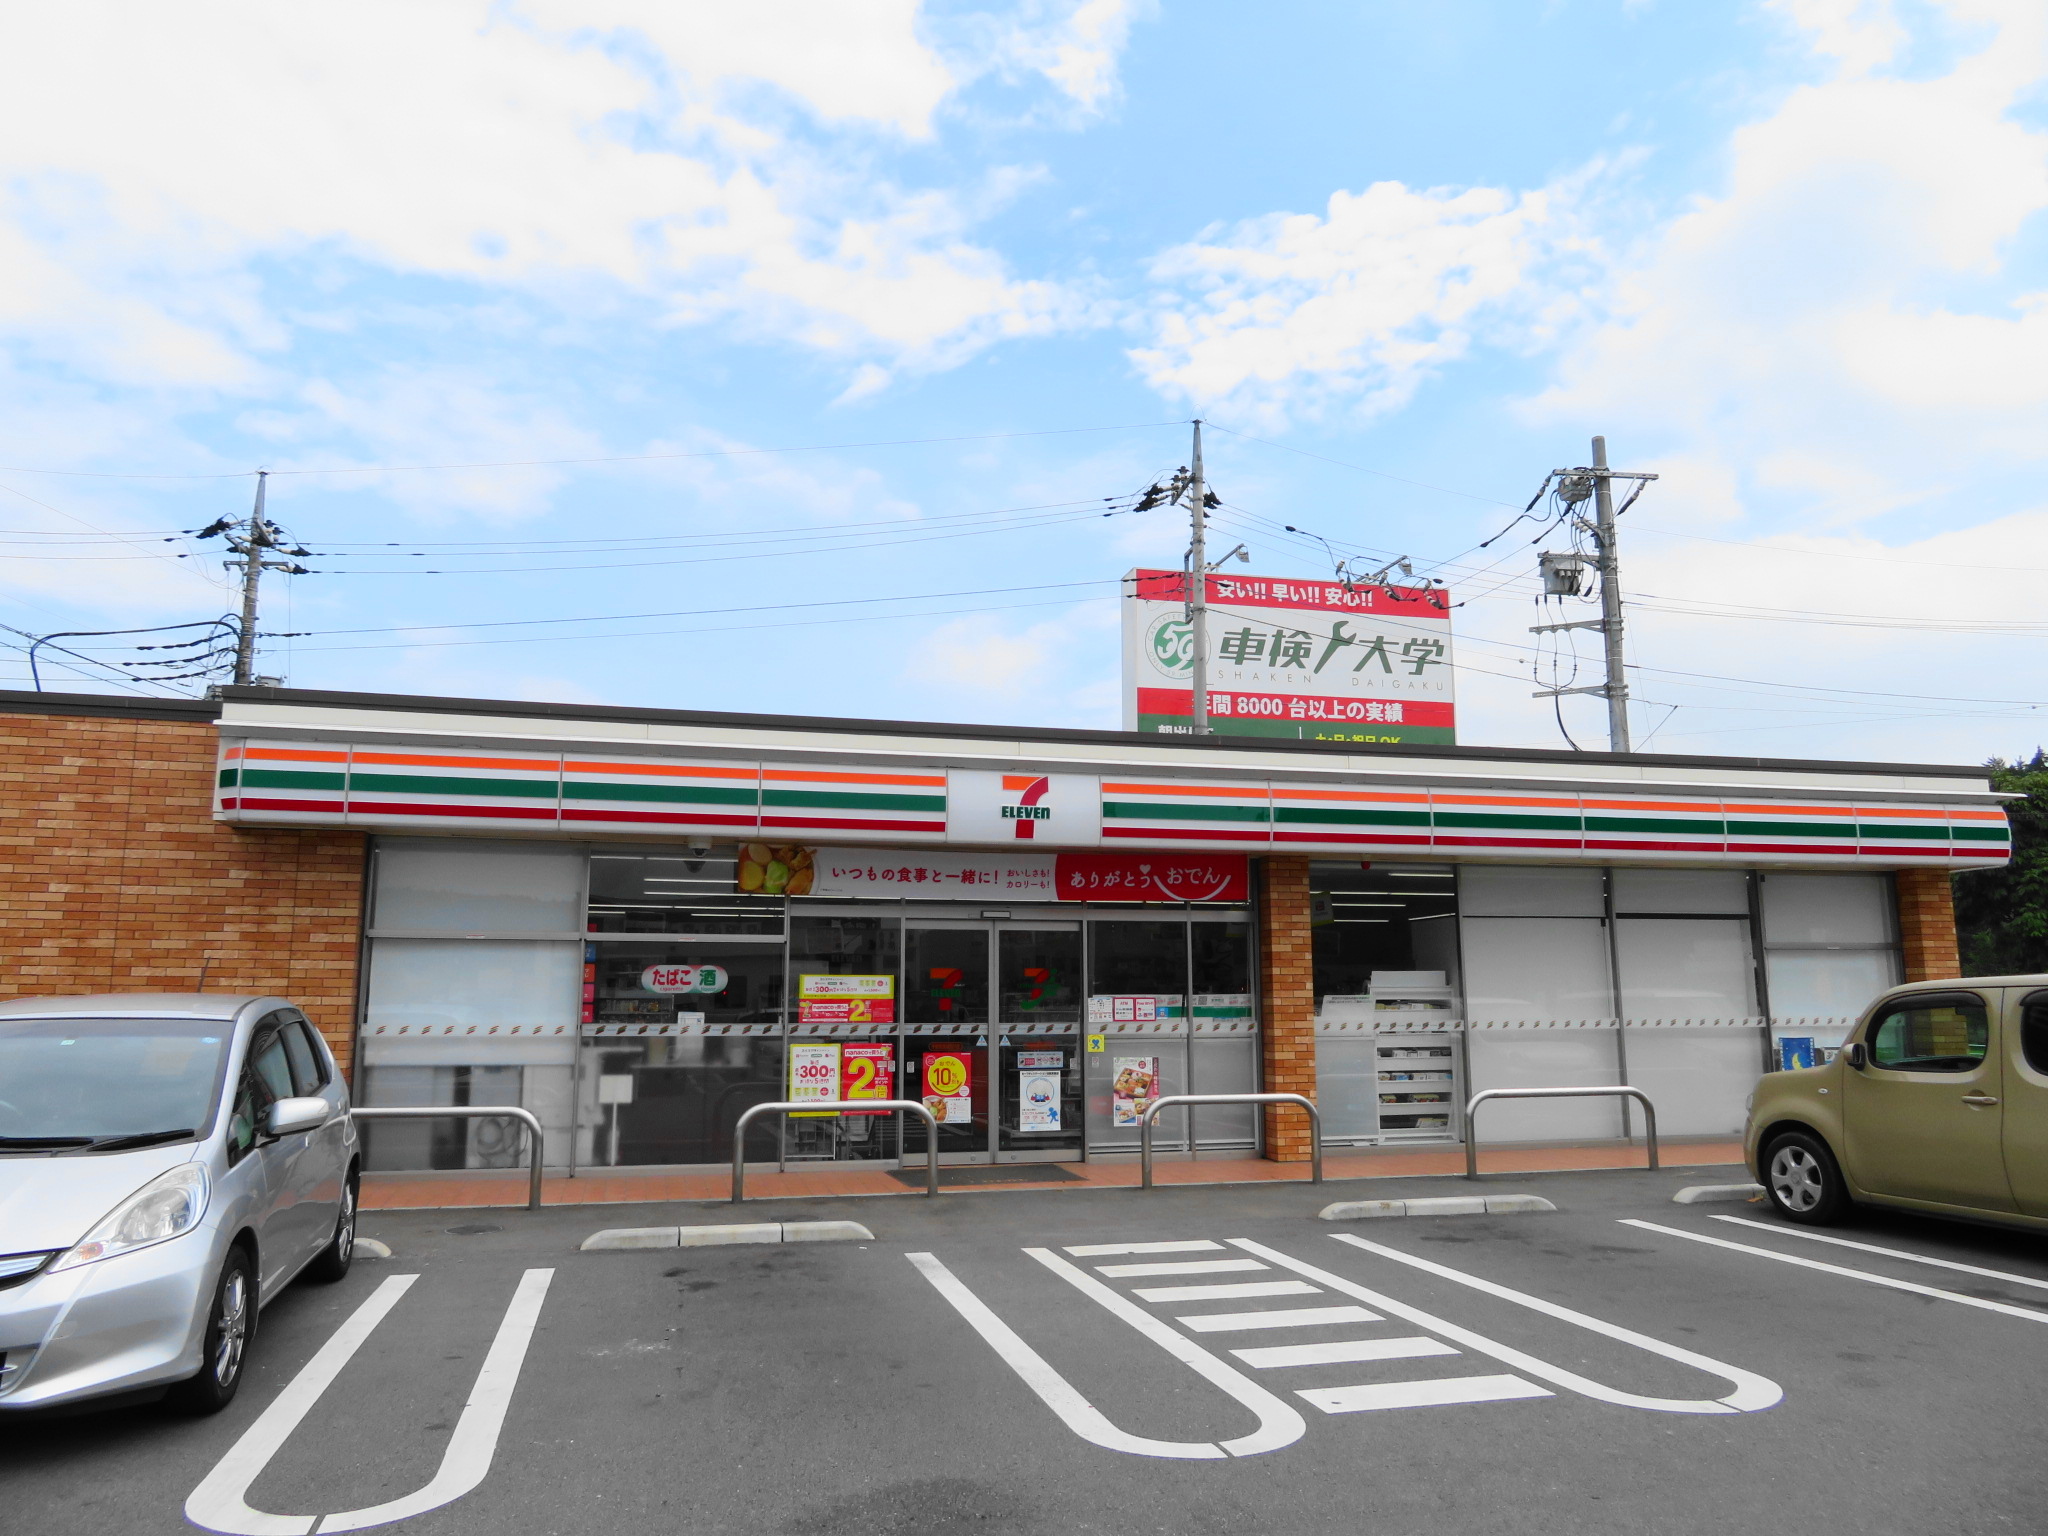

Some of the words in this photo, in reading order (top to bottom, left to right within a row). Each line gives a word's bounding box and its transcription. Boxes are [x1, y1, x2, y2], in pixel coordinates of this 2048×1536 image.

[1272, 583, 1320, 602] 早い!!
[1325, 587, 1373, 608] 安心!!
[1219, 627, 1313, 669] 車検
[1353, 635, 1445, 676] 大学
[1218, 670, 1312, 684] SHAKEN
[1352, 678, 1444, 691] DAIGAKU
[1237, 697, 1283, 715] 8000
[1288, 698, 1404, 723] 台以上の実績
[832, 866, 998, 885] いつもの食事と一緒に!
[1167, 866, 1220, 884] おでん
[652, 969, 691, 986] たばこ
[699, 969, 717, 986] 酒
